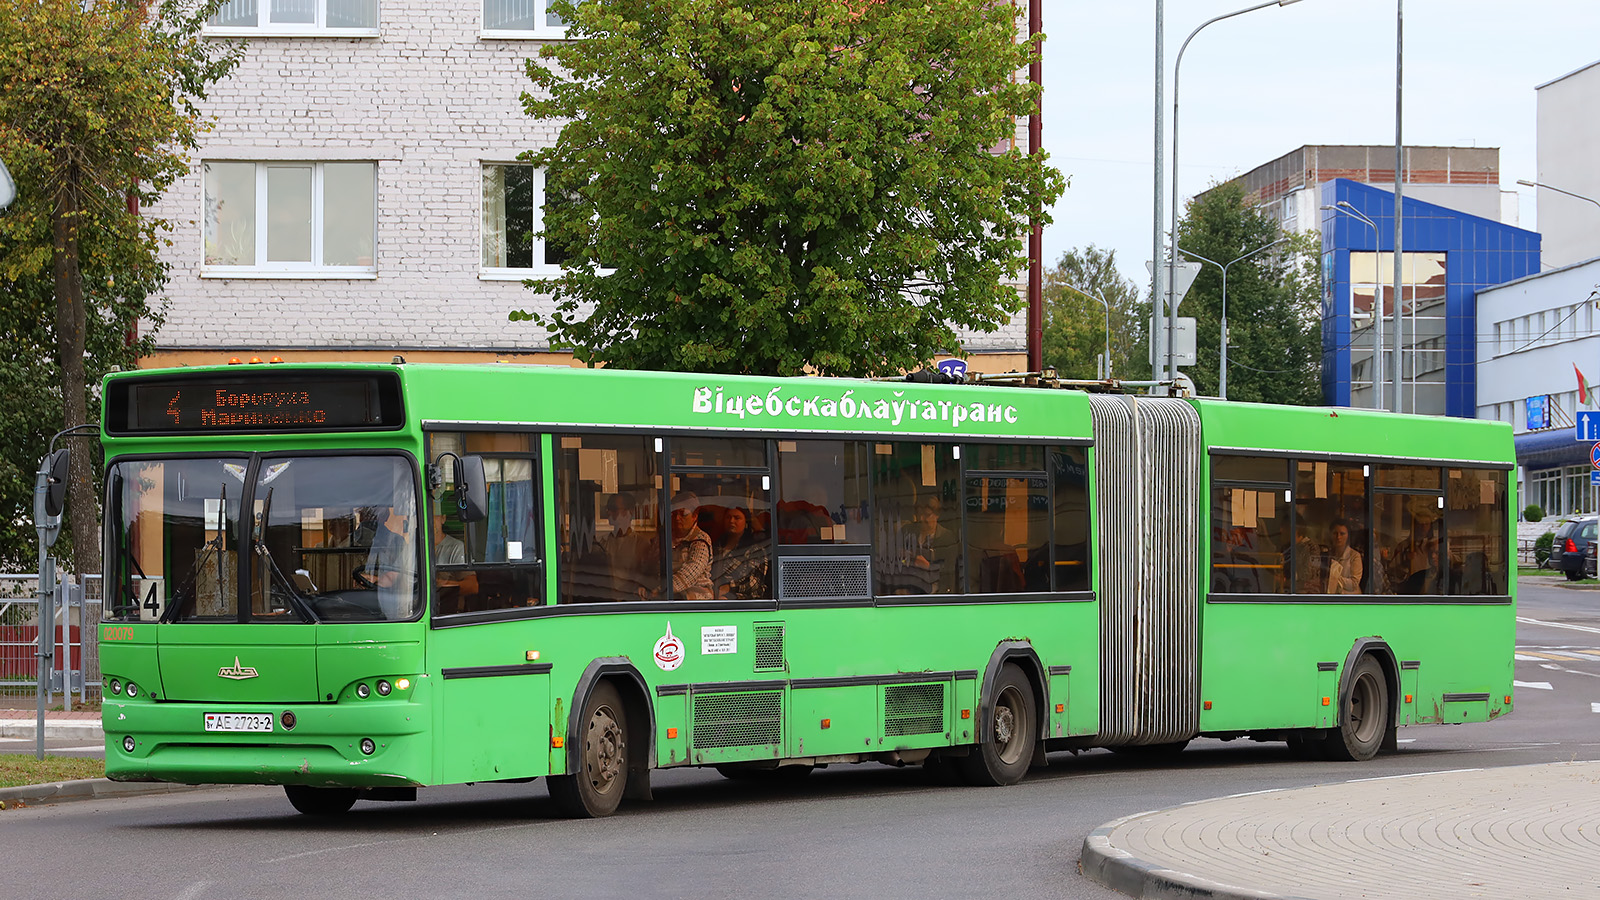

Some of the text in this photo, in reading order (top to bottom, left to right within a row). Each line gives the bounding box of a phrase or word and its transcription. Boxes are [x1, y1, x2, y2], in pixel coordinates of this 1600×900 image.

[692, 386, 1018, 427] Віцебскаблаўтатранс
[143, 582, 160, 617] 4
[103, 626, 134, 640] 020079
[216, 716, 232, 729] AE
[234, 716, 271, 730] 2723-2
